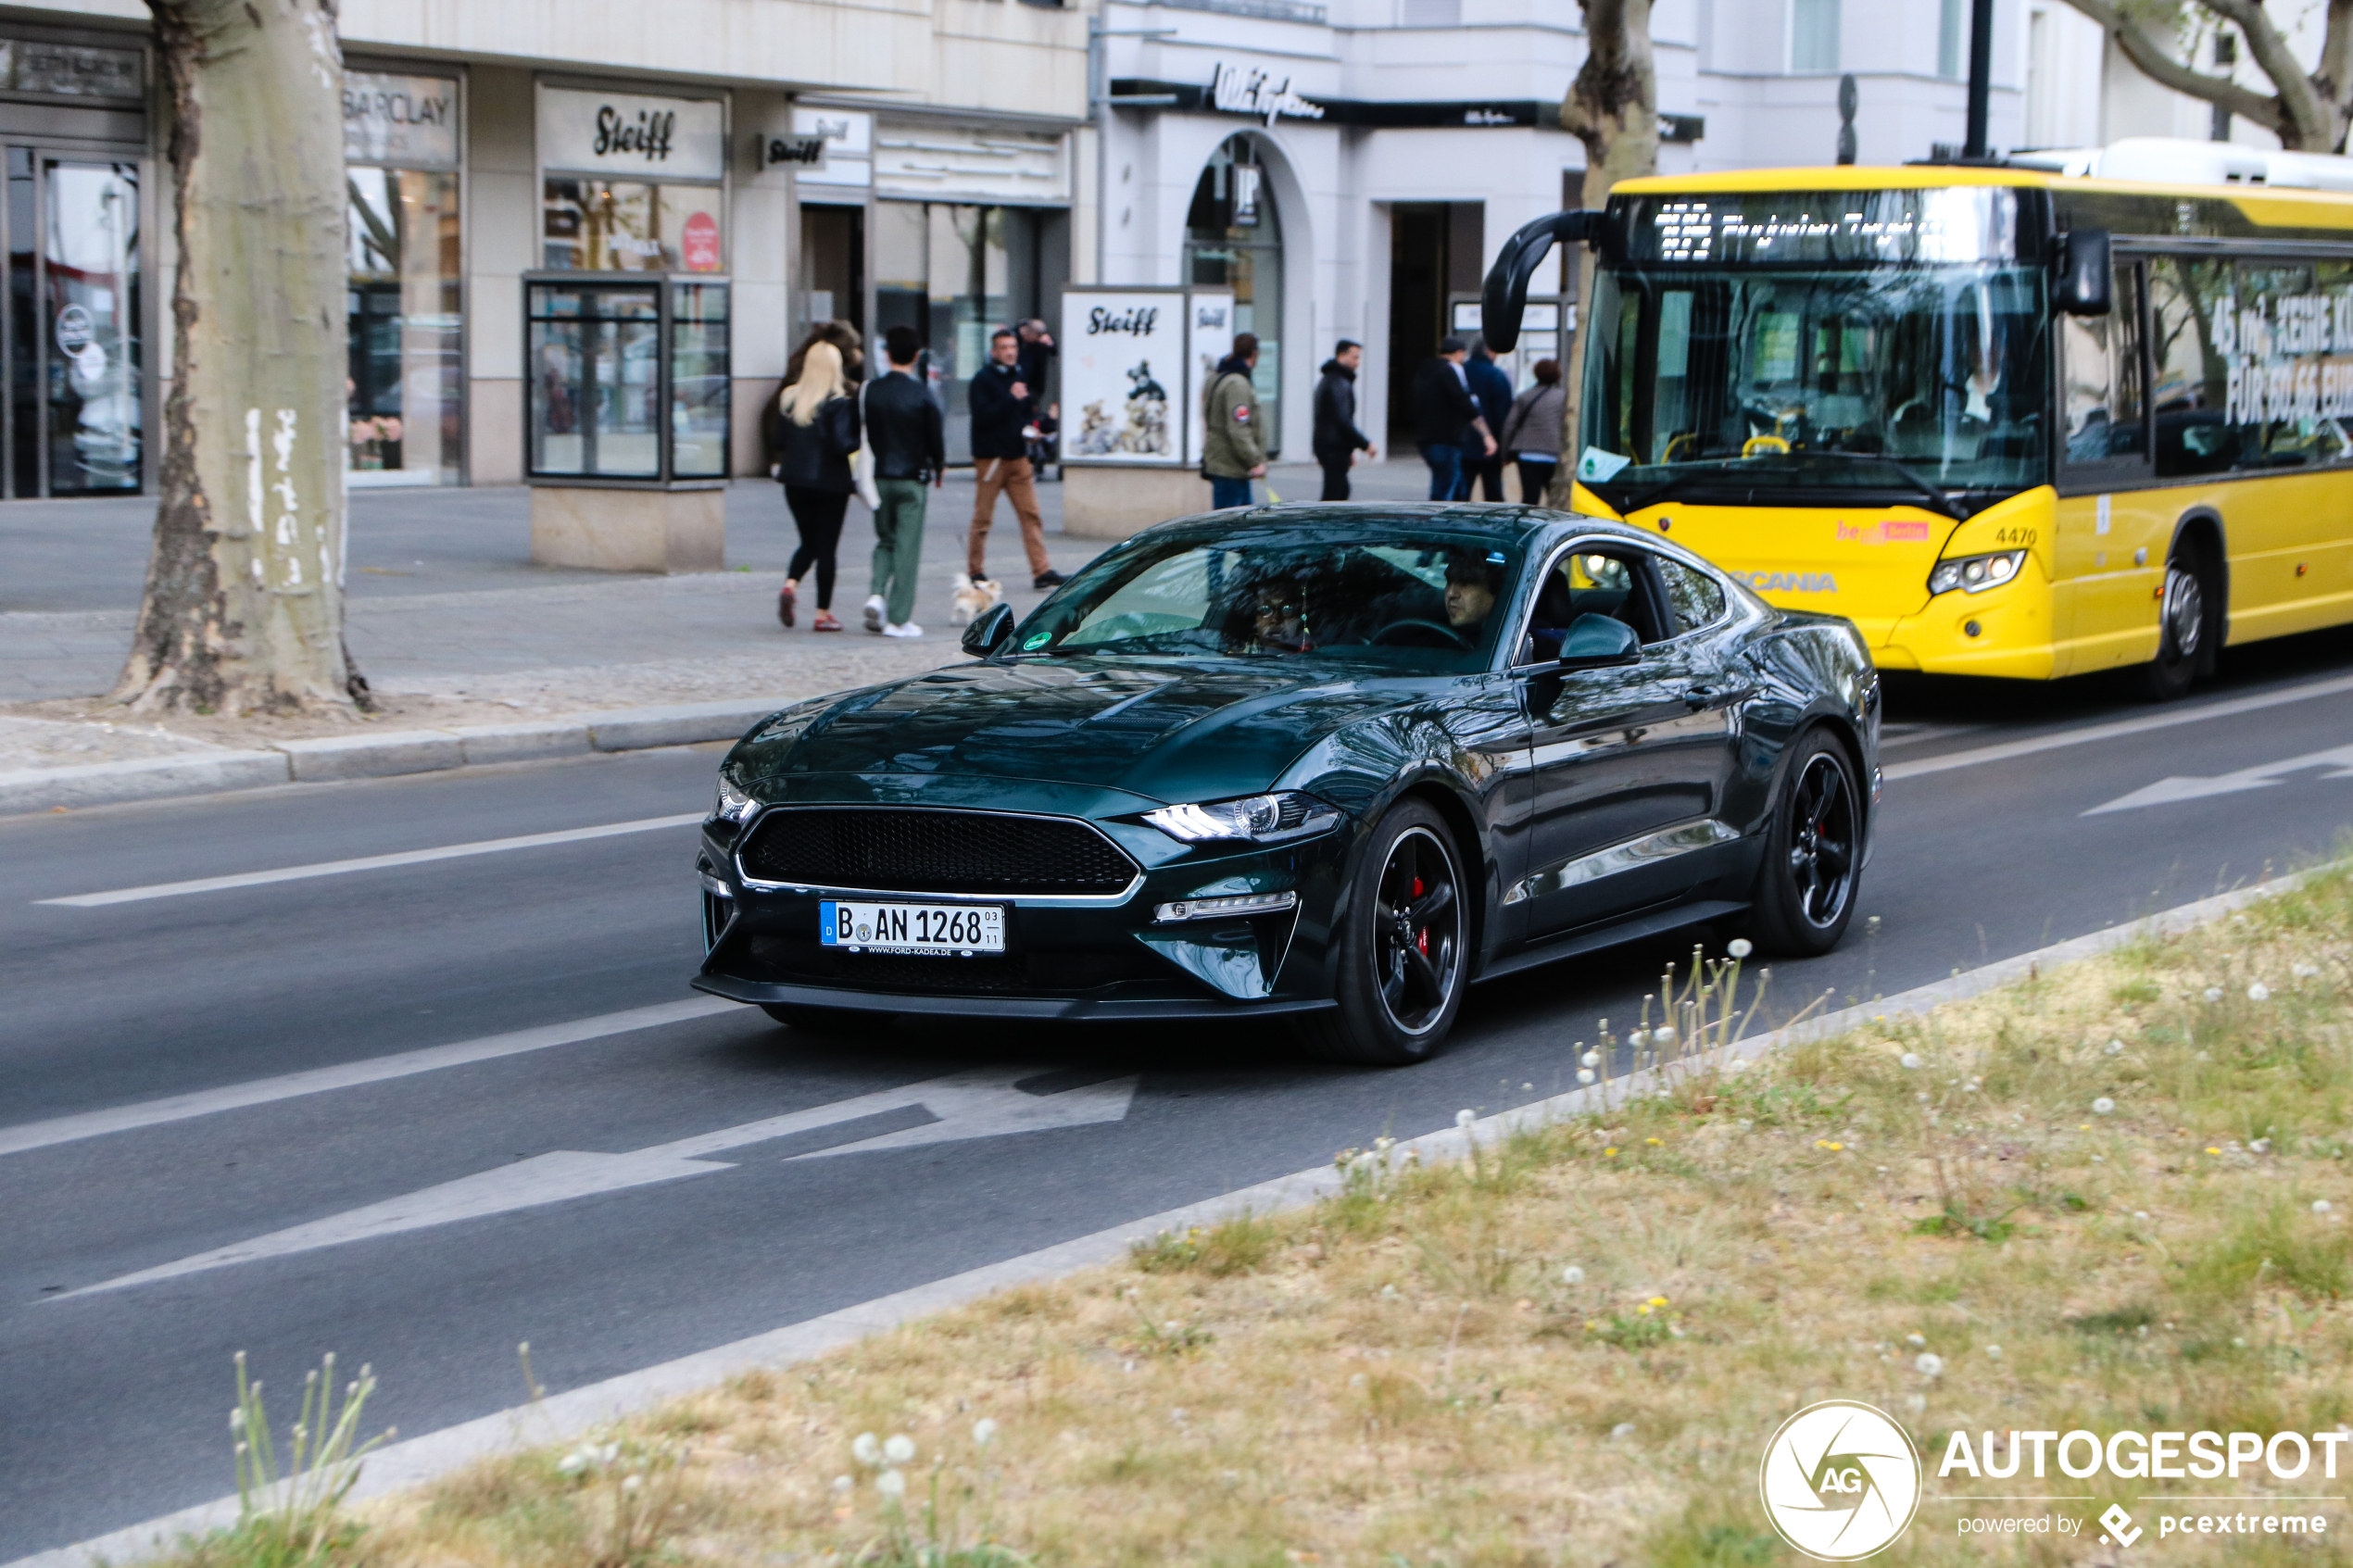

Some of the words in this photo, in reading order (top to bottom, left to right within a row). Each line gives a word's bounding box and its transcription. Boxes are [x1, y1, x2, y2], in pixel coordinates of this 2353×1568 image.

[341, 90, 450, 126] BARCLAY
[593, 105, 674, 162] Steiff
[768, 139, 821, 165] Steiff
[1088, 307, 1159, 336] Steiff
[1836, 521, 1859, 541] be
[1995, 527, 2038, 545] 4470
[1732, 571, 1838, 593] SCANIA
[838, 907, 853, 939] B
[875, 909, 908, 941] AN
[915, 909, 982, 945] 1268
[985, 911, 998, 921] 03
[825, 926, 833, 936] D
[987, 934, 997, 944] 11
[868, 947, 951, 956] WWW.FORD-KADEA.DE
